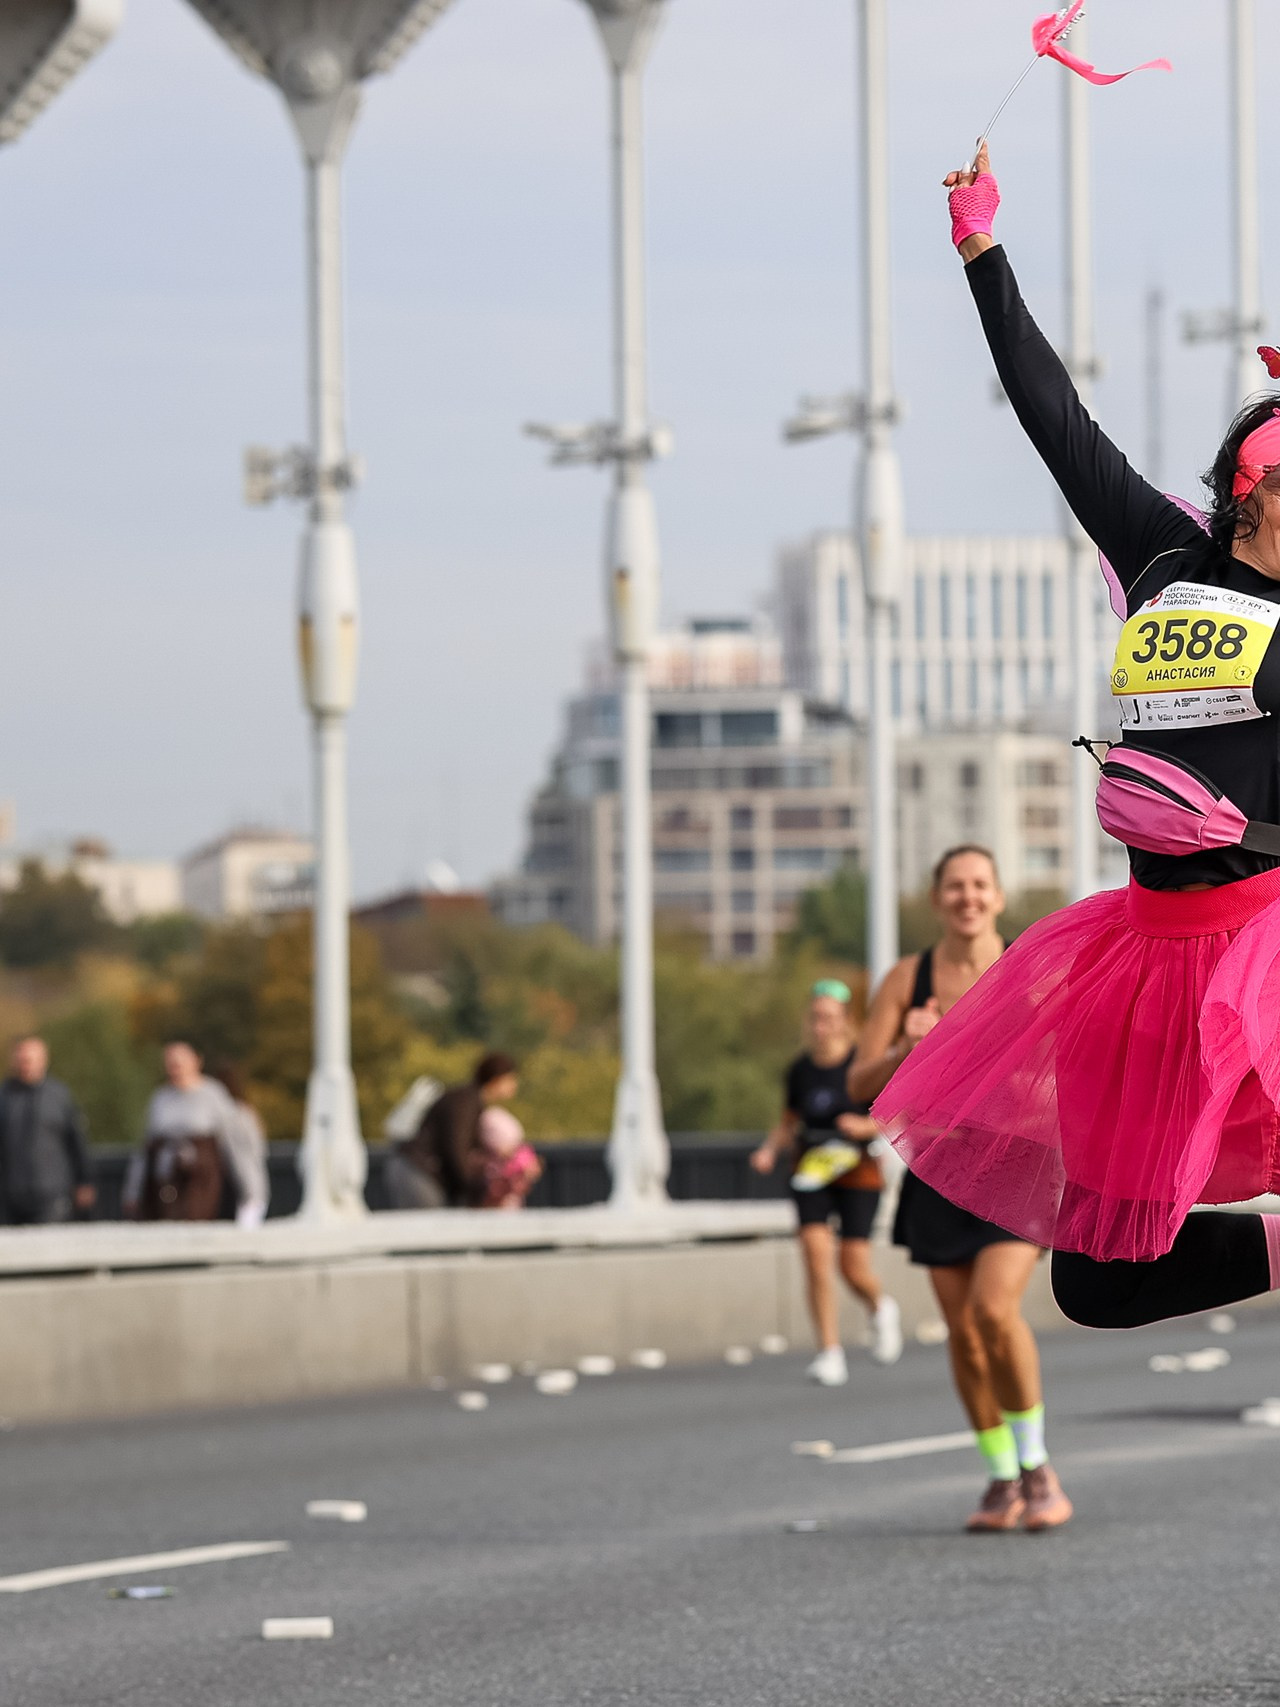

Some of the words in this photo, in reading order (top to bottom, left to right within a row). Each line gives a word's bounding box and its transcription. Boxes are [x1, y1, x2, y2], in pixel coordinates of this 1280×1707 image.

[1164, 592, 1218, 601] МОСКОВСКИЙ
[1132, 618, 1248, 664] 3588
[1146, 666, 1216, 682] АНАСТАСИЯ
